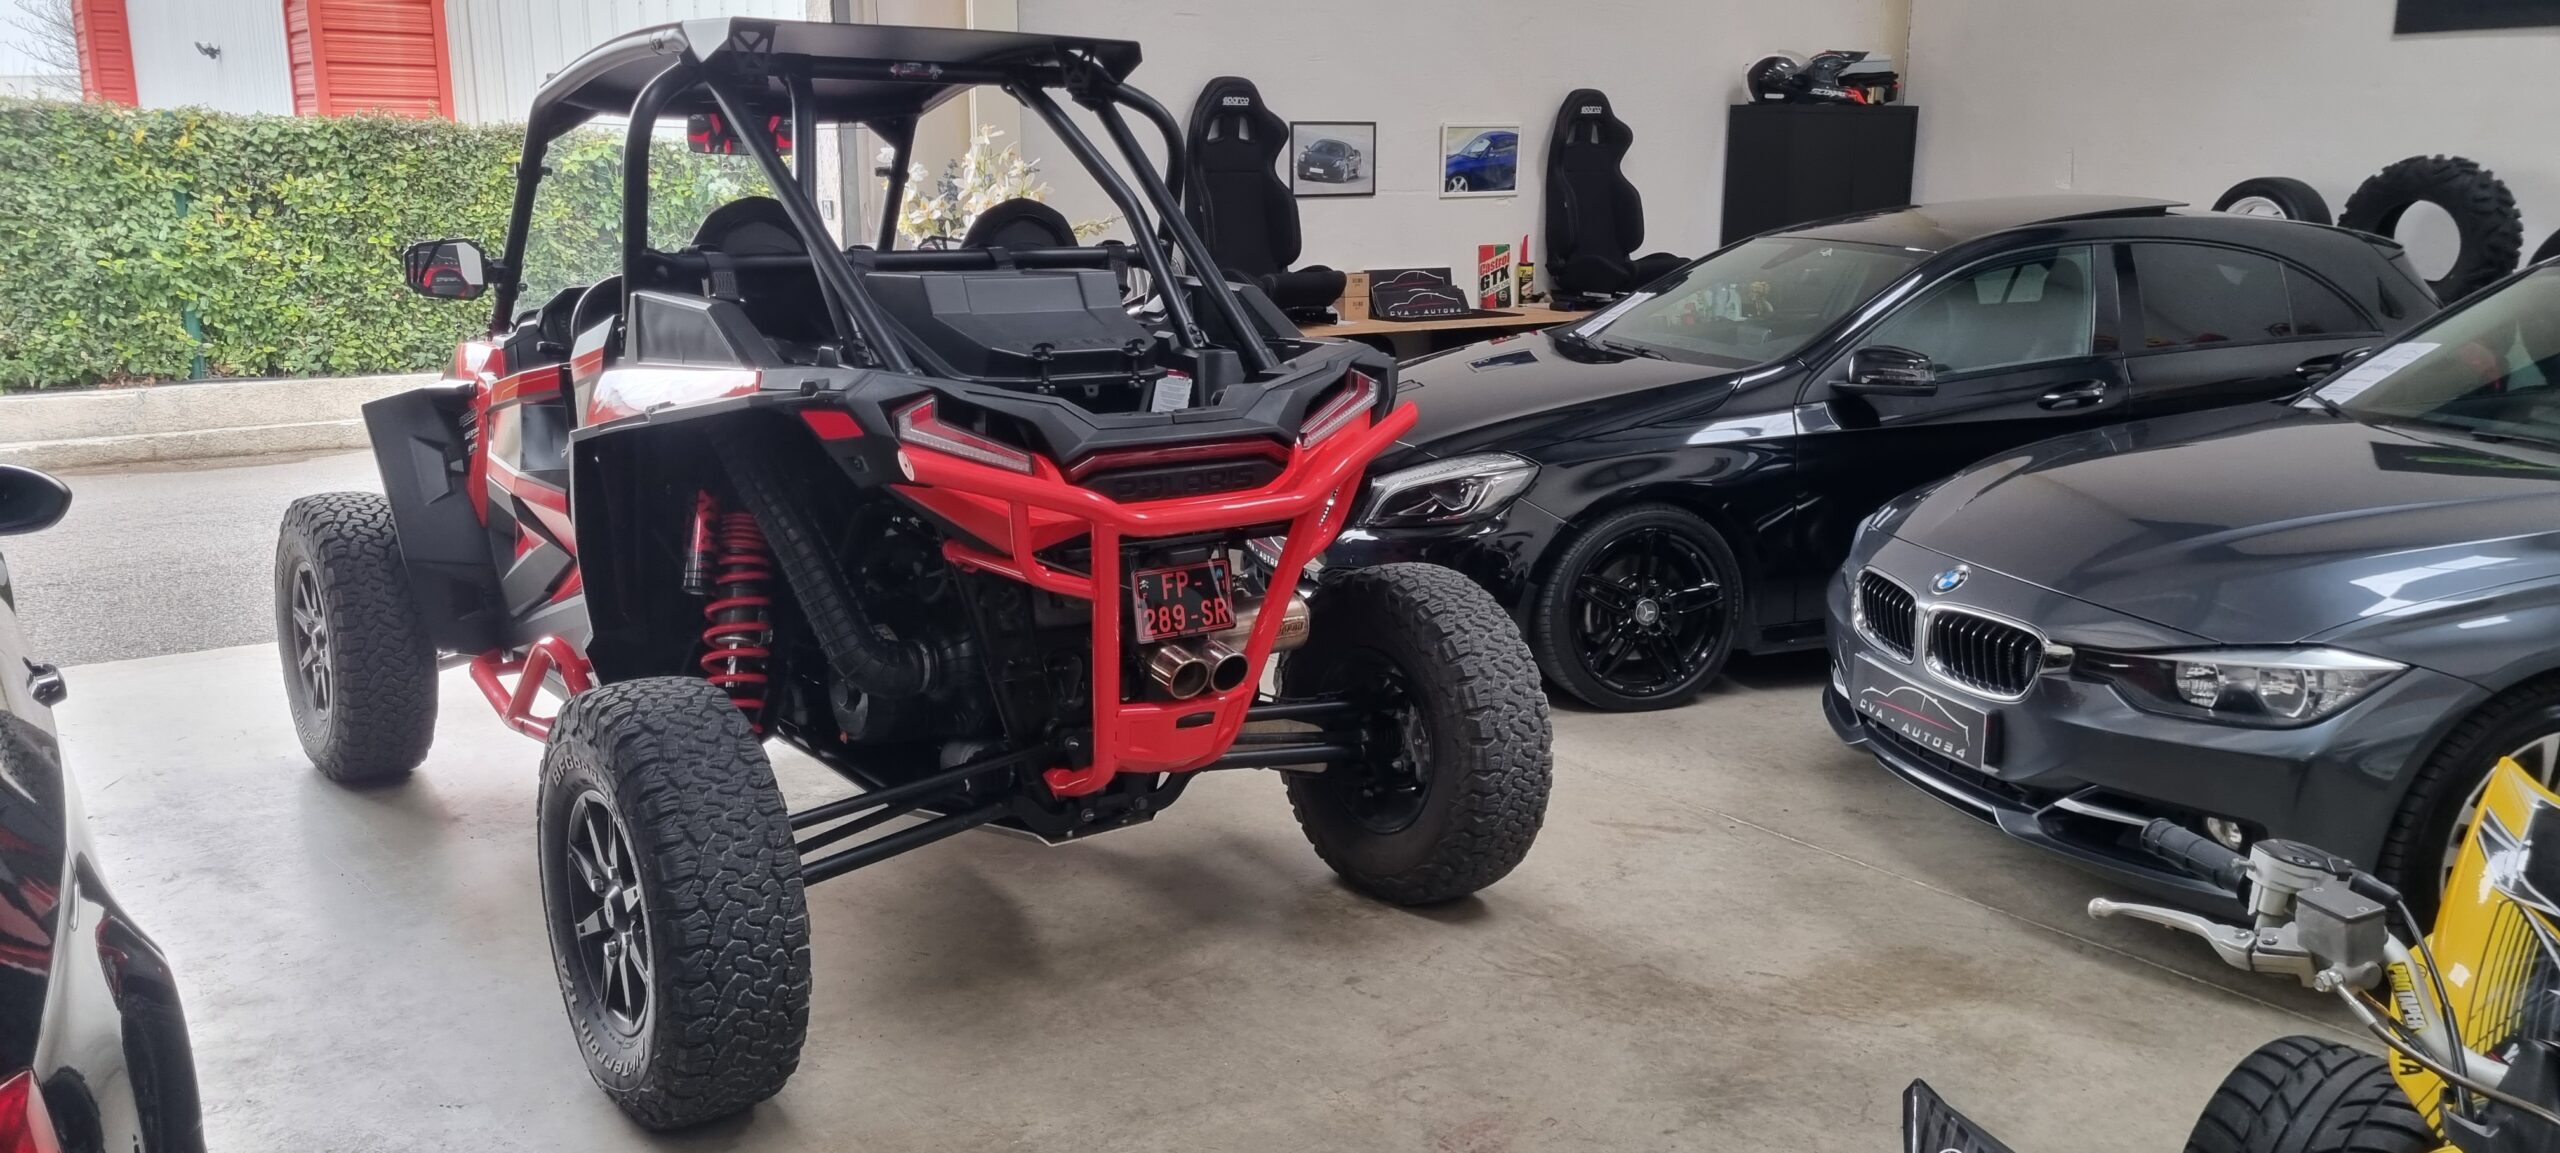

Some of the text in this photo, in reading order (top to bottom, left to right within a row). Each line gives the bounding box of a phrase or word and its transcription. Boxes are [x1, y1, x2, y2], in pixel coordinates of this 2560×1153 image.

[1480, 264, 1510, 292] GTX
[1860, 698, 1883, 720] CVA
[1901, 722, 1967, 759] AUTO34
